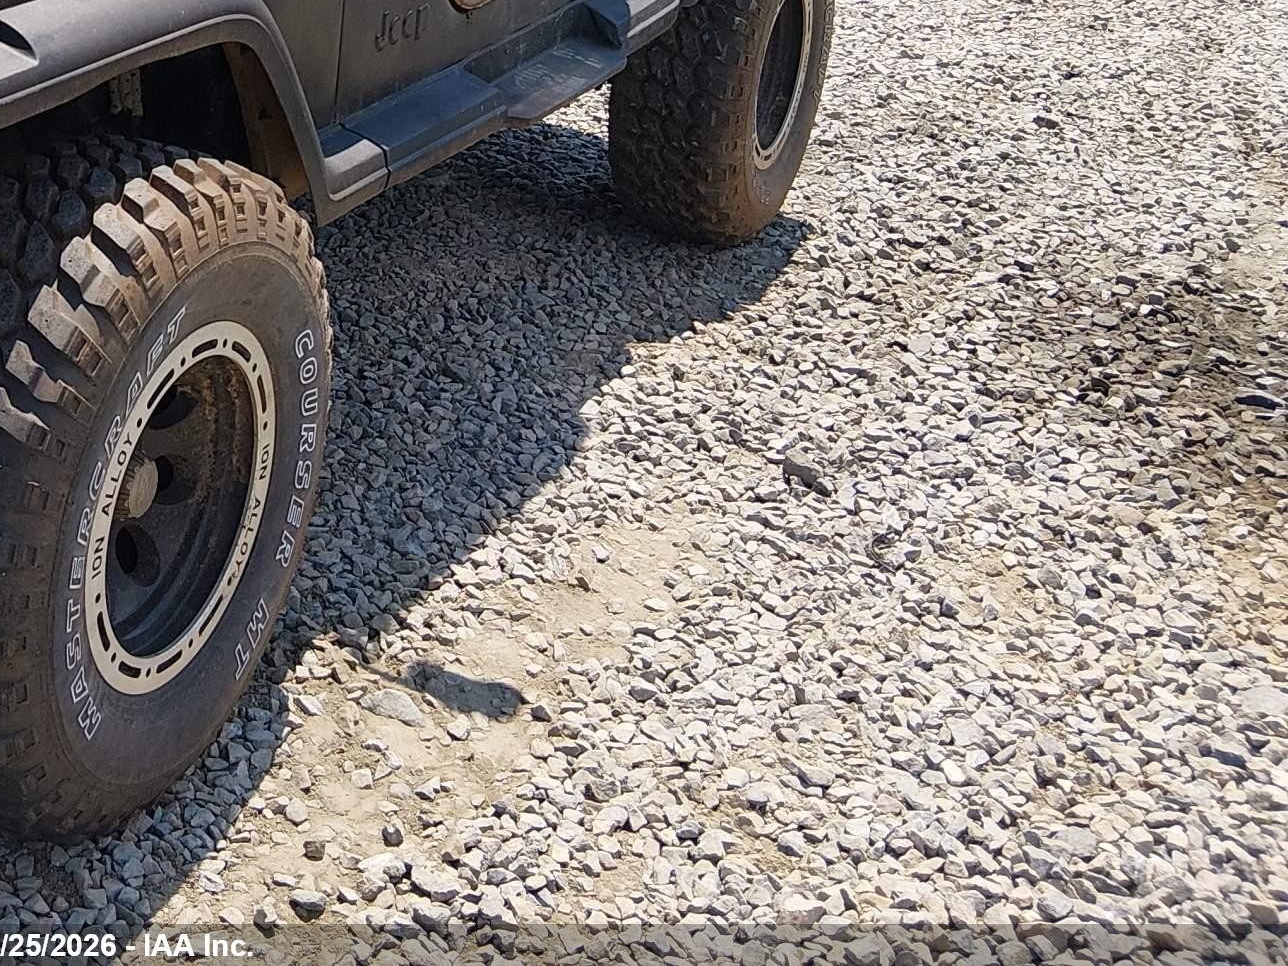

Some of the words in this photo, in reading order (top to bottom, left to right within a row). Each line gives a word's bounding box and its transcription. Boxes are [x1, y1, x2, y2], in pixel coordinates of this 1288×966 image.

[258, 443, 271, 481] ION
[273, 328, 316, 572] COURSER
[91, 536, 106, 580] ION
[101, 432, 133, 517] ALLOY
[235, 494, 261, 569] ALLOY
[234, 596, 271, 682] MT
